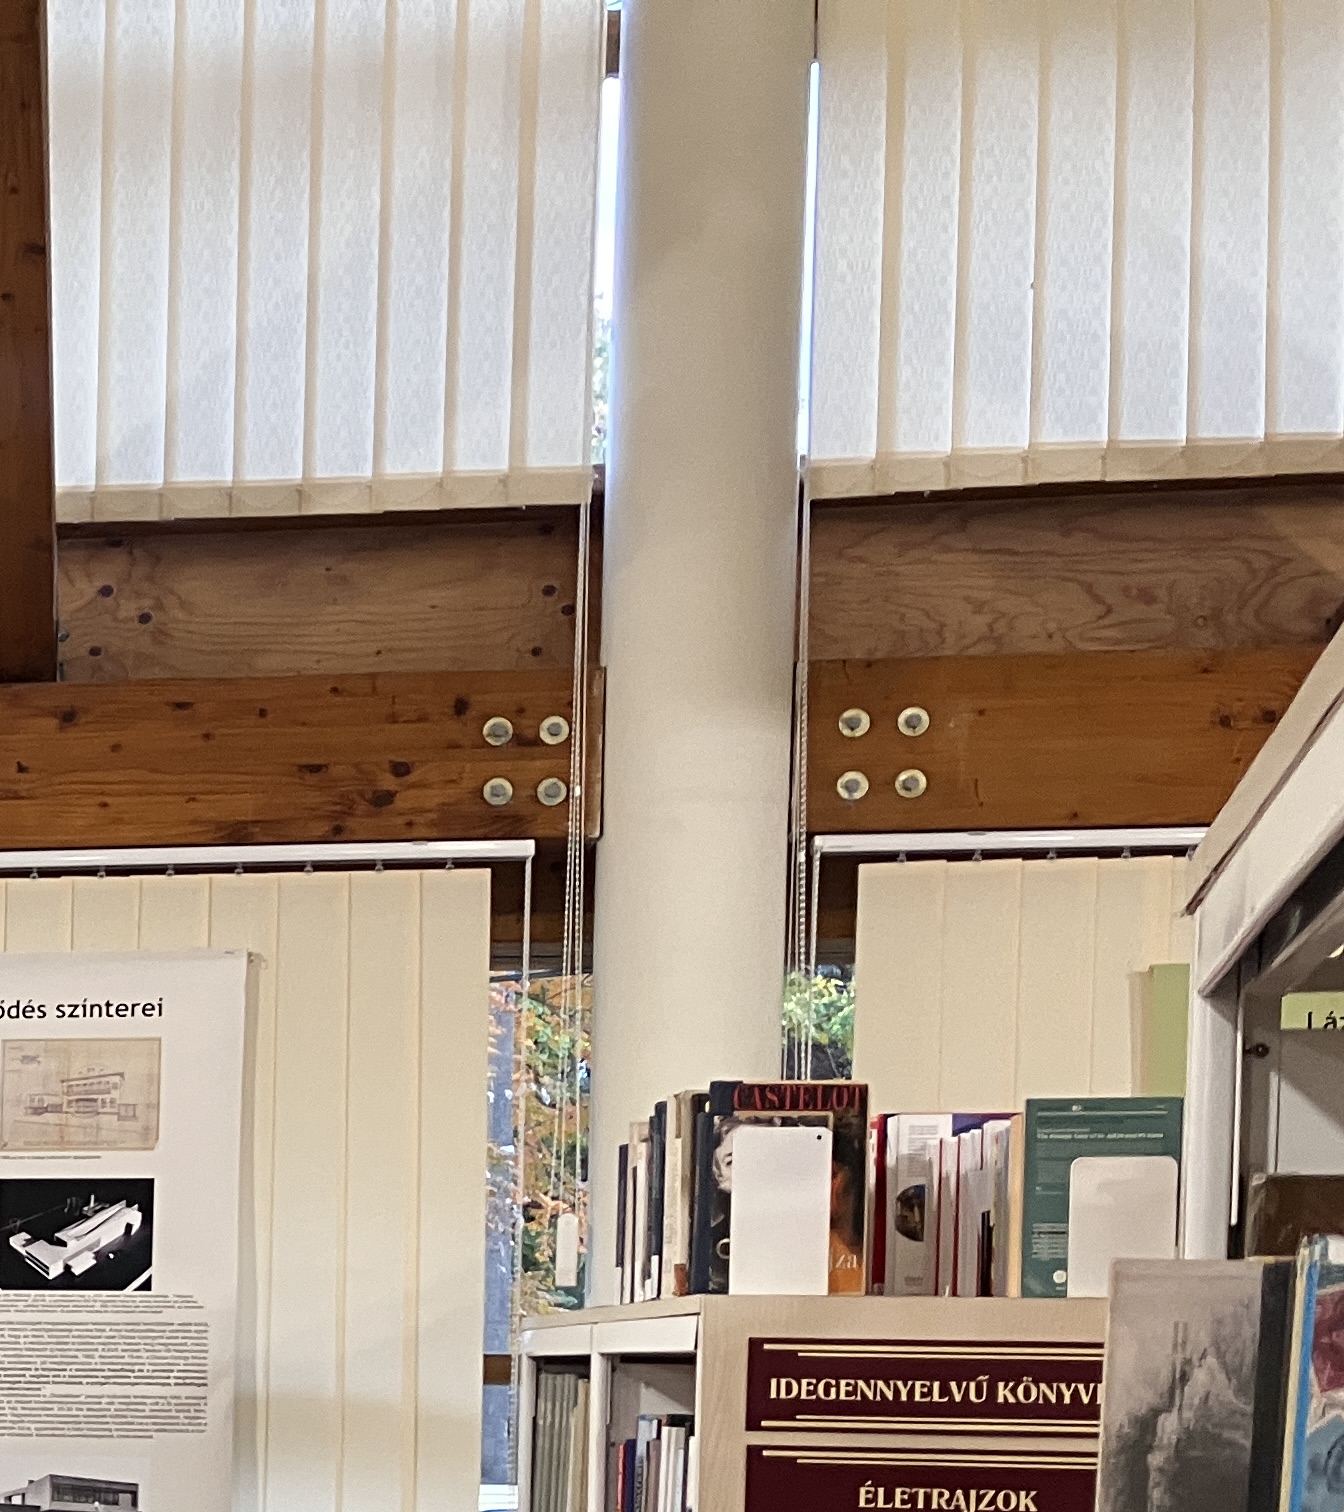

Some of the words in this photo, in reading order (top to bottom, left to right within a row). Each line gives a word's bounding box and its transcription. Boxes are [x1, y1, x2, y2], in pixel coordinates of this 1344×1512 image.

[55, 997, 164, 1019] színterei
[732, 1084, 863, 1112] CASTELOT
[768, 1374, 991, 1403] IDEGENNYELVŰ
